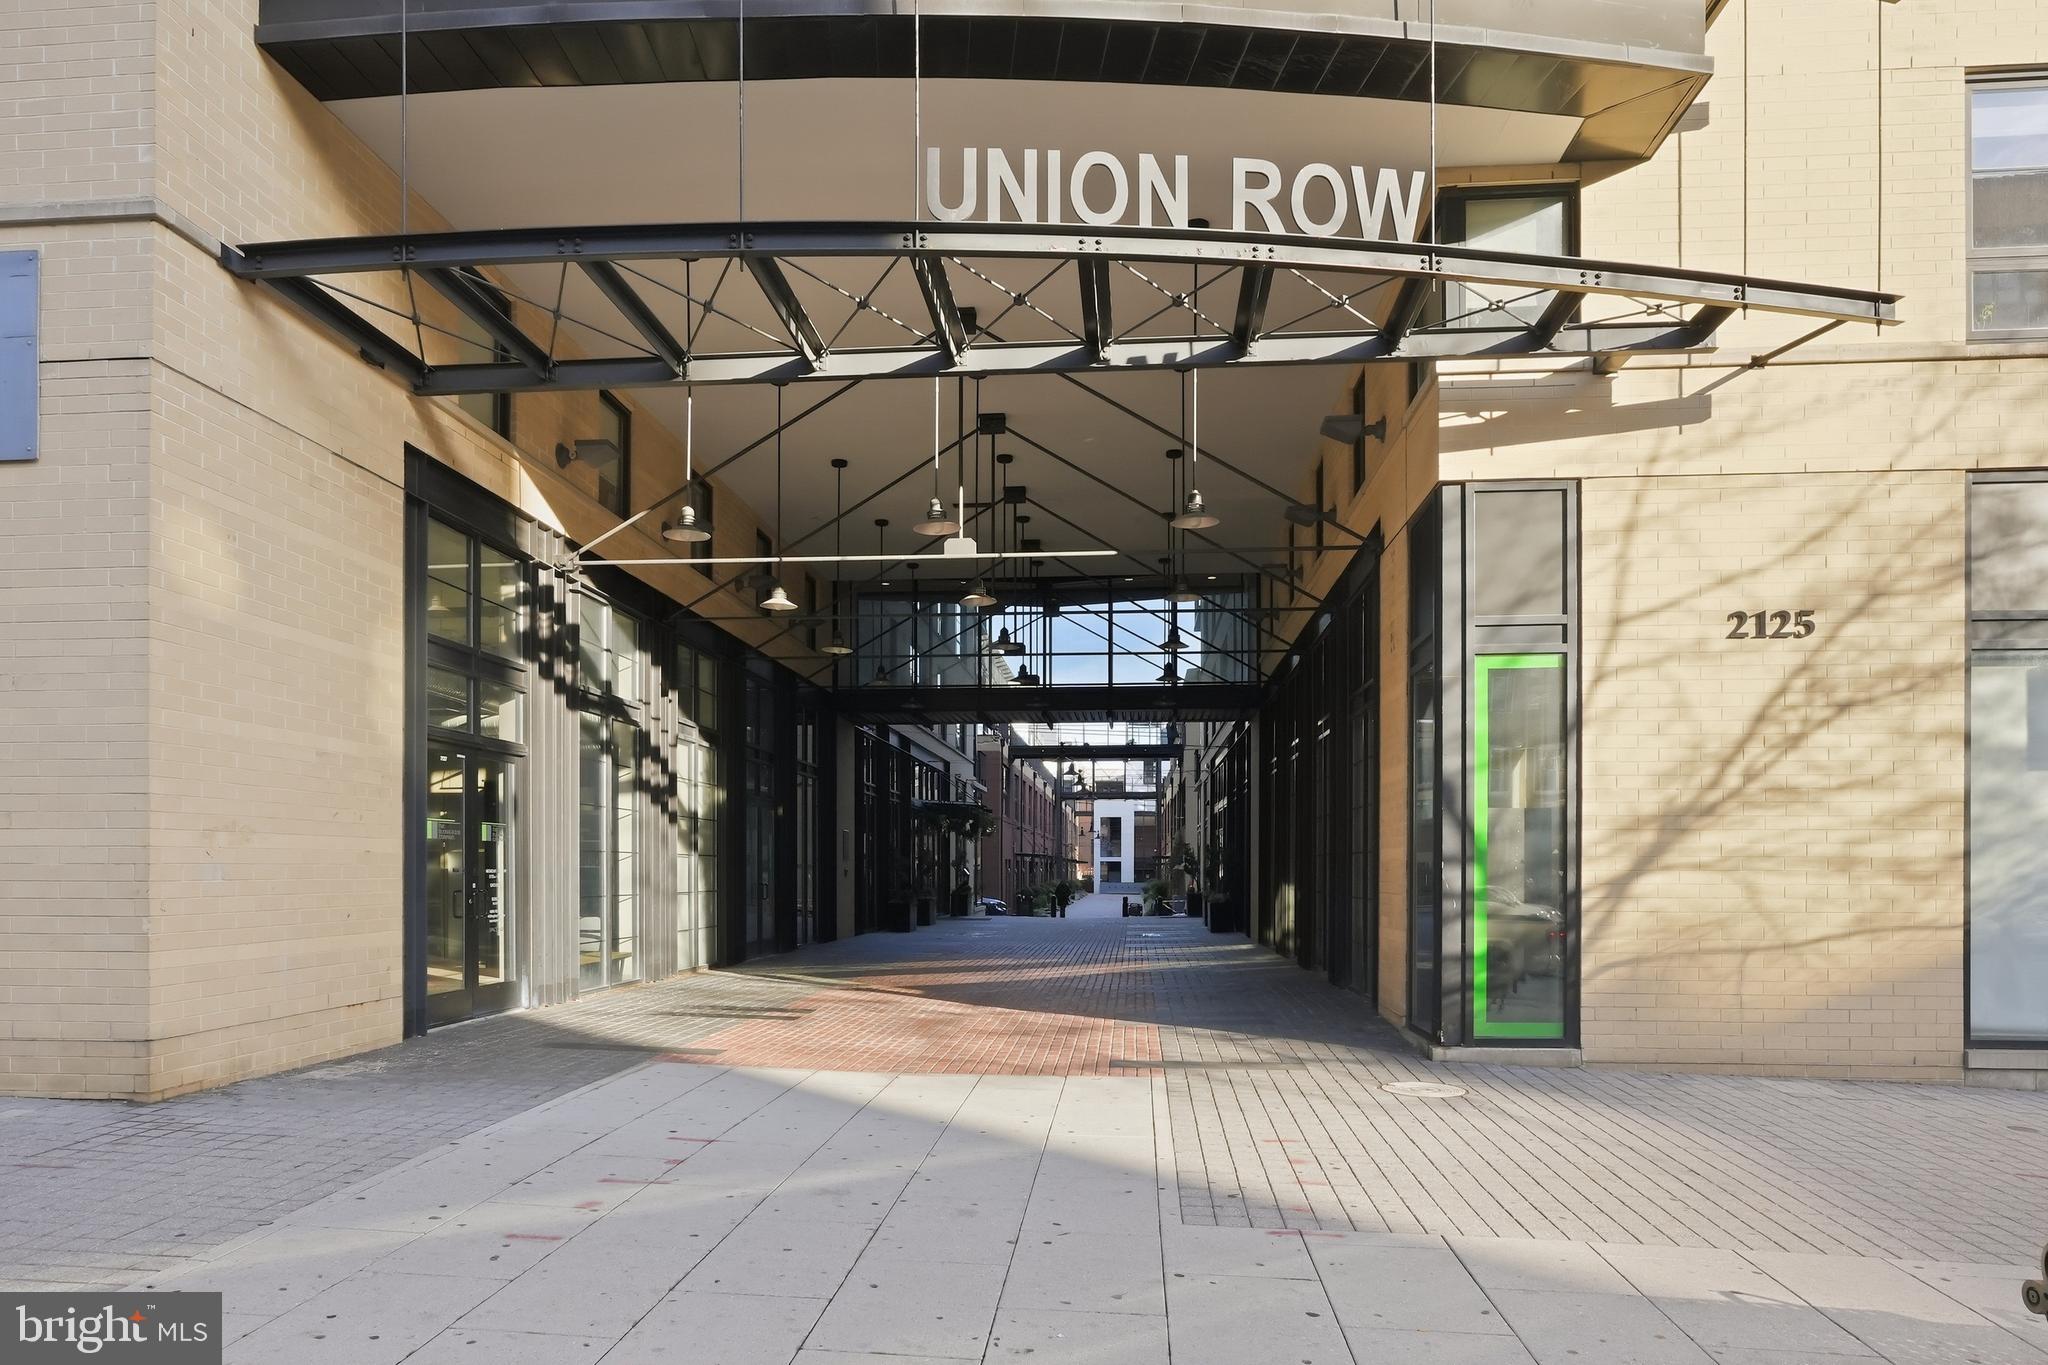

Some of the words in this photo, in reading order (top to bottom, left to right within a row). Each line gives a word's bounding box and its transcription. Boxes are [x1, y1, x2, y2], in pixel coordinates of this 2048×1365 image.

[927, 147, 1188, 227] UNION
[1233, 157, 1426, 243] ROW
[1725, 610, 1816, 639] 2125
